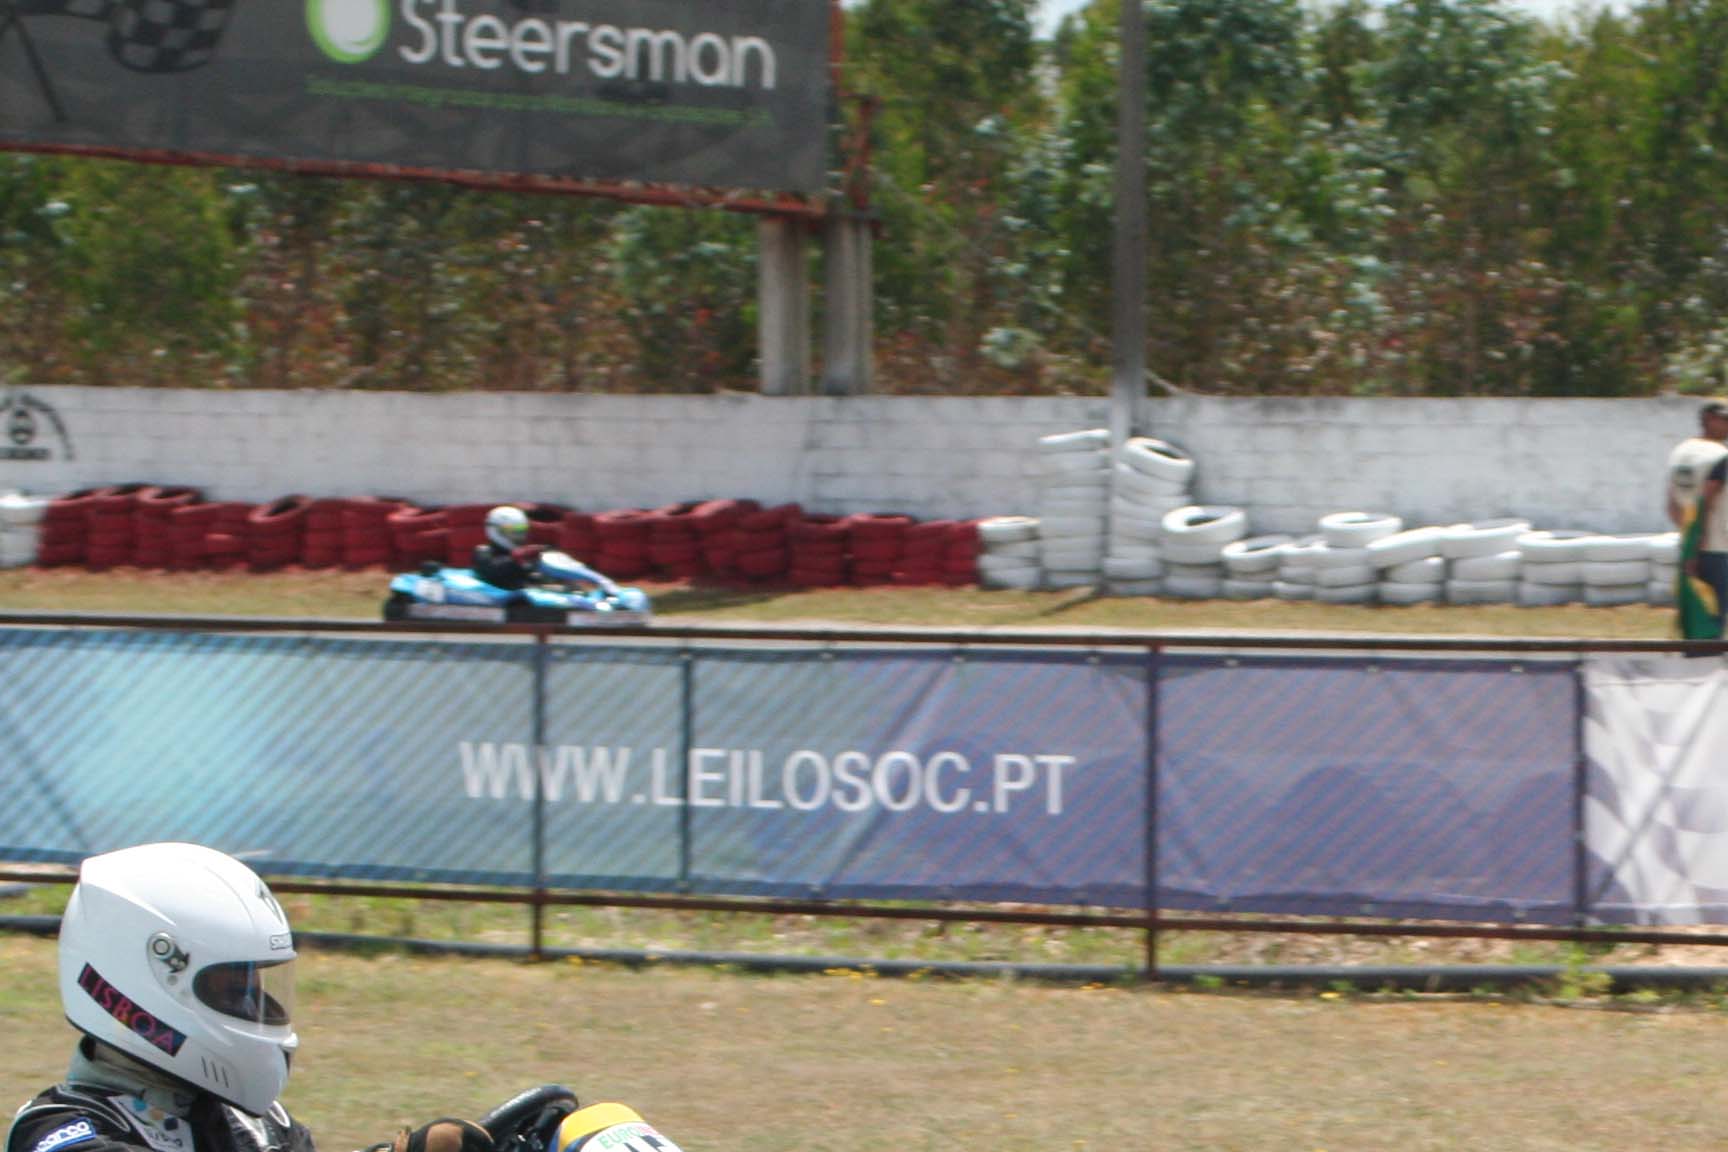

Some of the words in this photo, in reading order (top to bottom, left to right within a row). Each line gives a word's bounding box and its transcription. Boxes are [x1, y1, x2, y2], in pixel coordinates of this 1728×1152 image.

[398, 0, 777, 89] Steersman
[459, 741, 1075, 814] WWW.LEILOSOC.PT
[80, 965, 174, 1054] LISBOA
